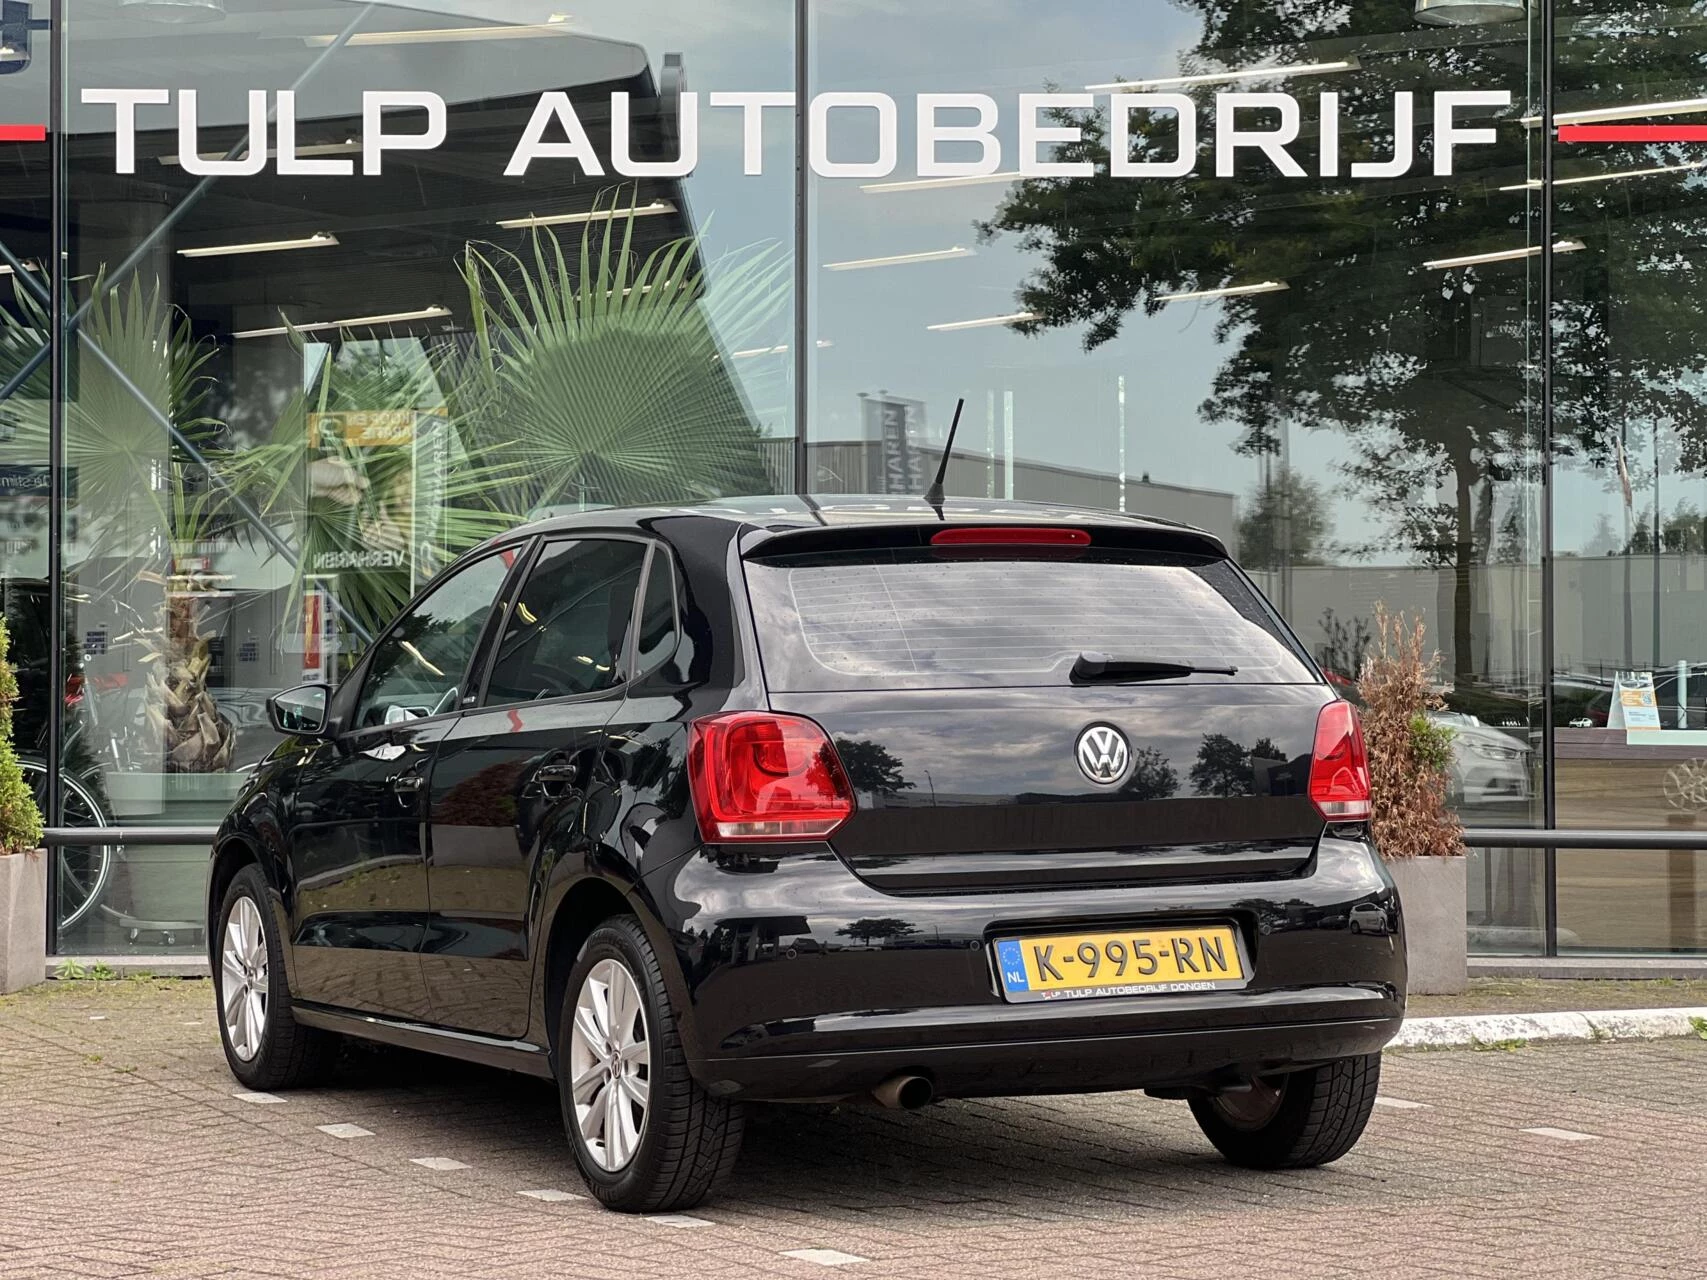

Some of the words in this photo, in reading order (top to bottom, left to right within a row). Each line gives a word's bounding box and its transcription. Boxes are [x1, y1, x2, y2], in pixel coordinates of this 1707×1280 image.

[81, 88, 447, 176] TULP
[503, 91, 1512, 178] AUTOBEDRIJF
[1033, 935, 1228, 982] K-995-RN
[1006, 971, 1025, 984] NL
[1064, 987, 1093, 998] TULP
[1095, 983, 1168, 997] AUTOBEDRIJF
[1171, 981, 1216, 992] DONGEN
